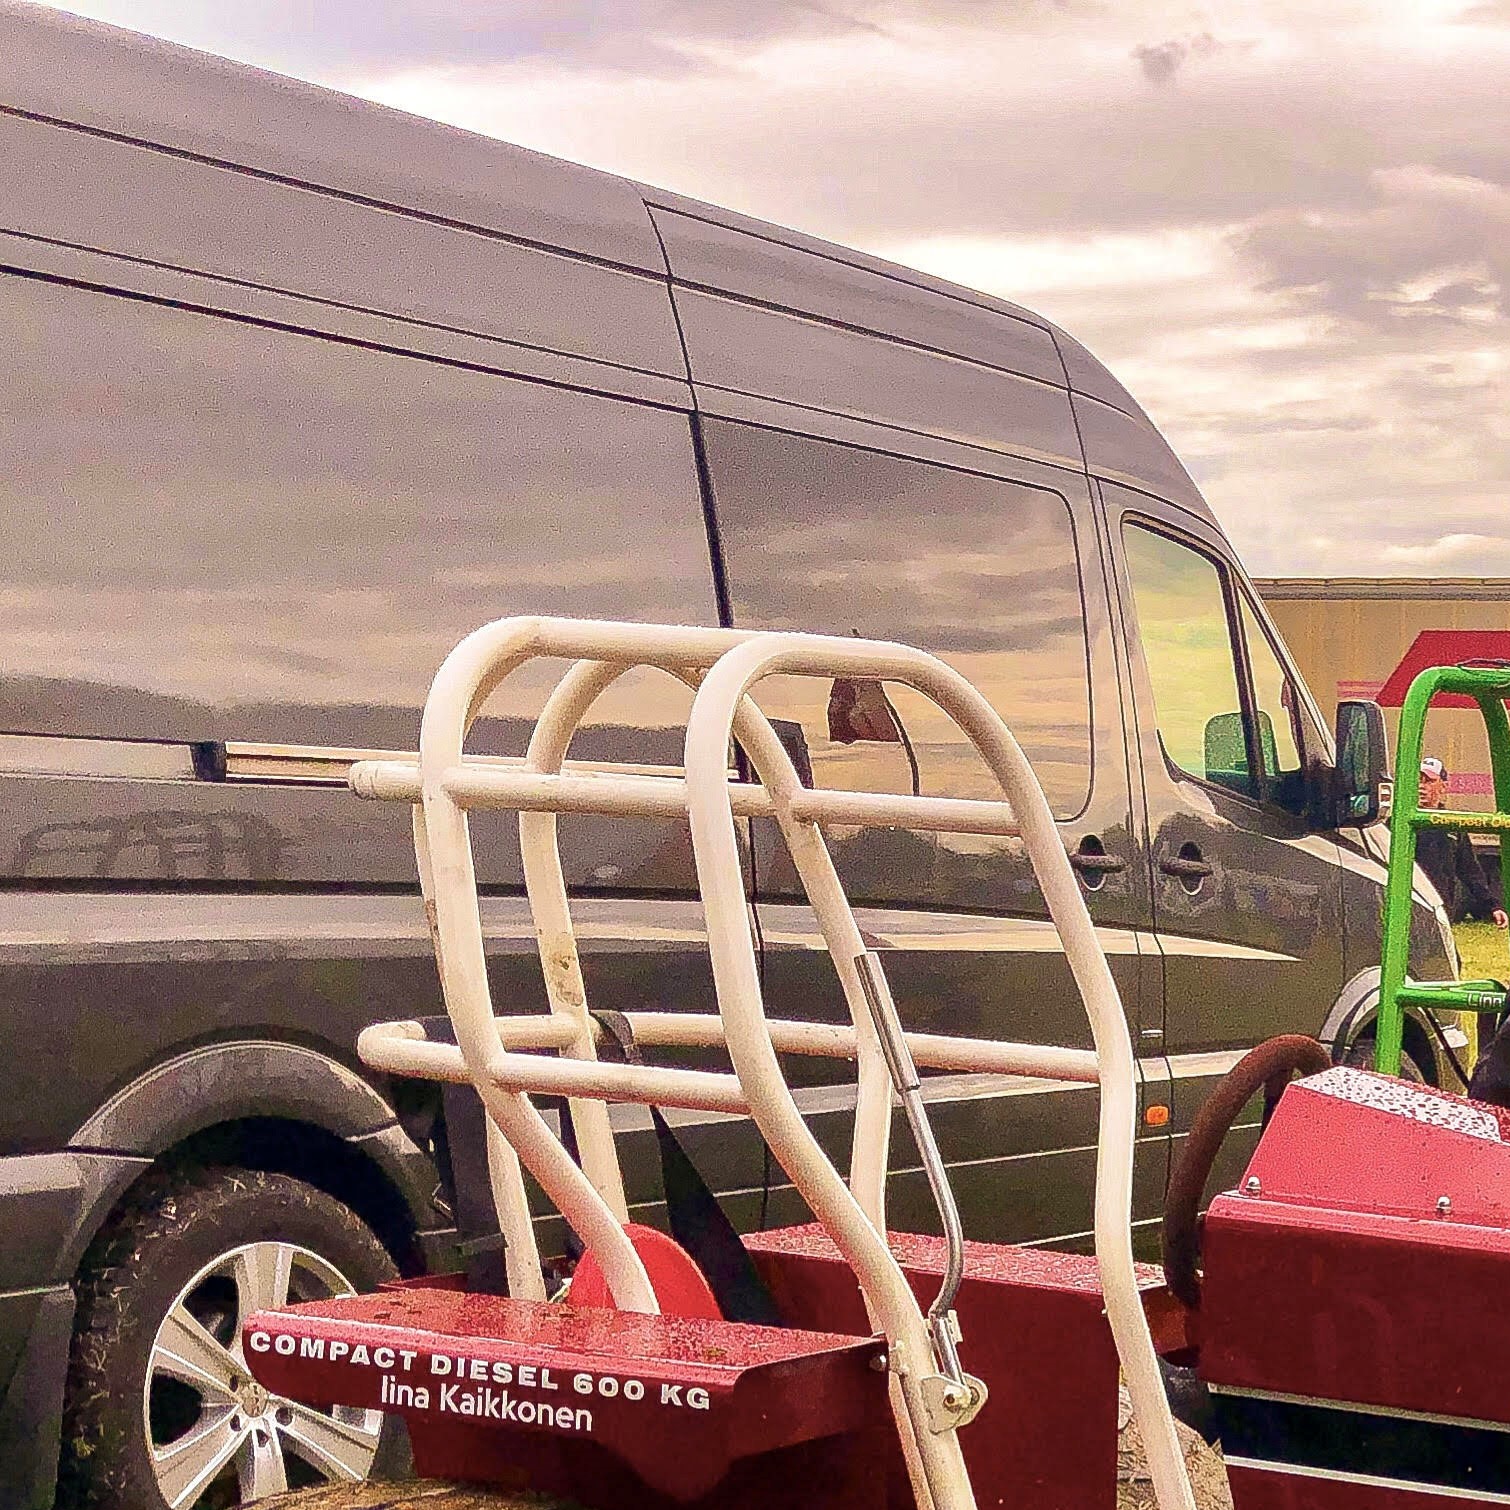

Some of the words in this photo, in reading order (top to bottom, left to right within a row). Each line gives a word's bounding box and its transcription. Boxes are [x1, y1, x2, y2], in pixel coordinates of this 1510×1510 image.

[1467, 992, 1502, 1007] Linn
[250, 1331, 417, 1371] COMPACT
[430, 1353, 559, 1390] DIESEL
[573, 1373, 645, 1401] 600
[660, 1382, 711, 1410] KG
[382, 1375, 430, 1409] Iina
[440, 1382, 593, 1432] Kaikkonen
